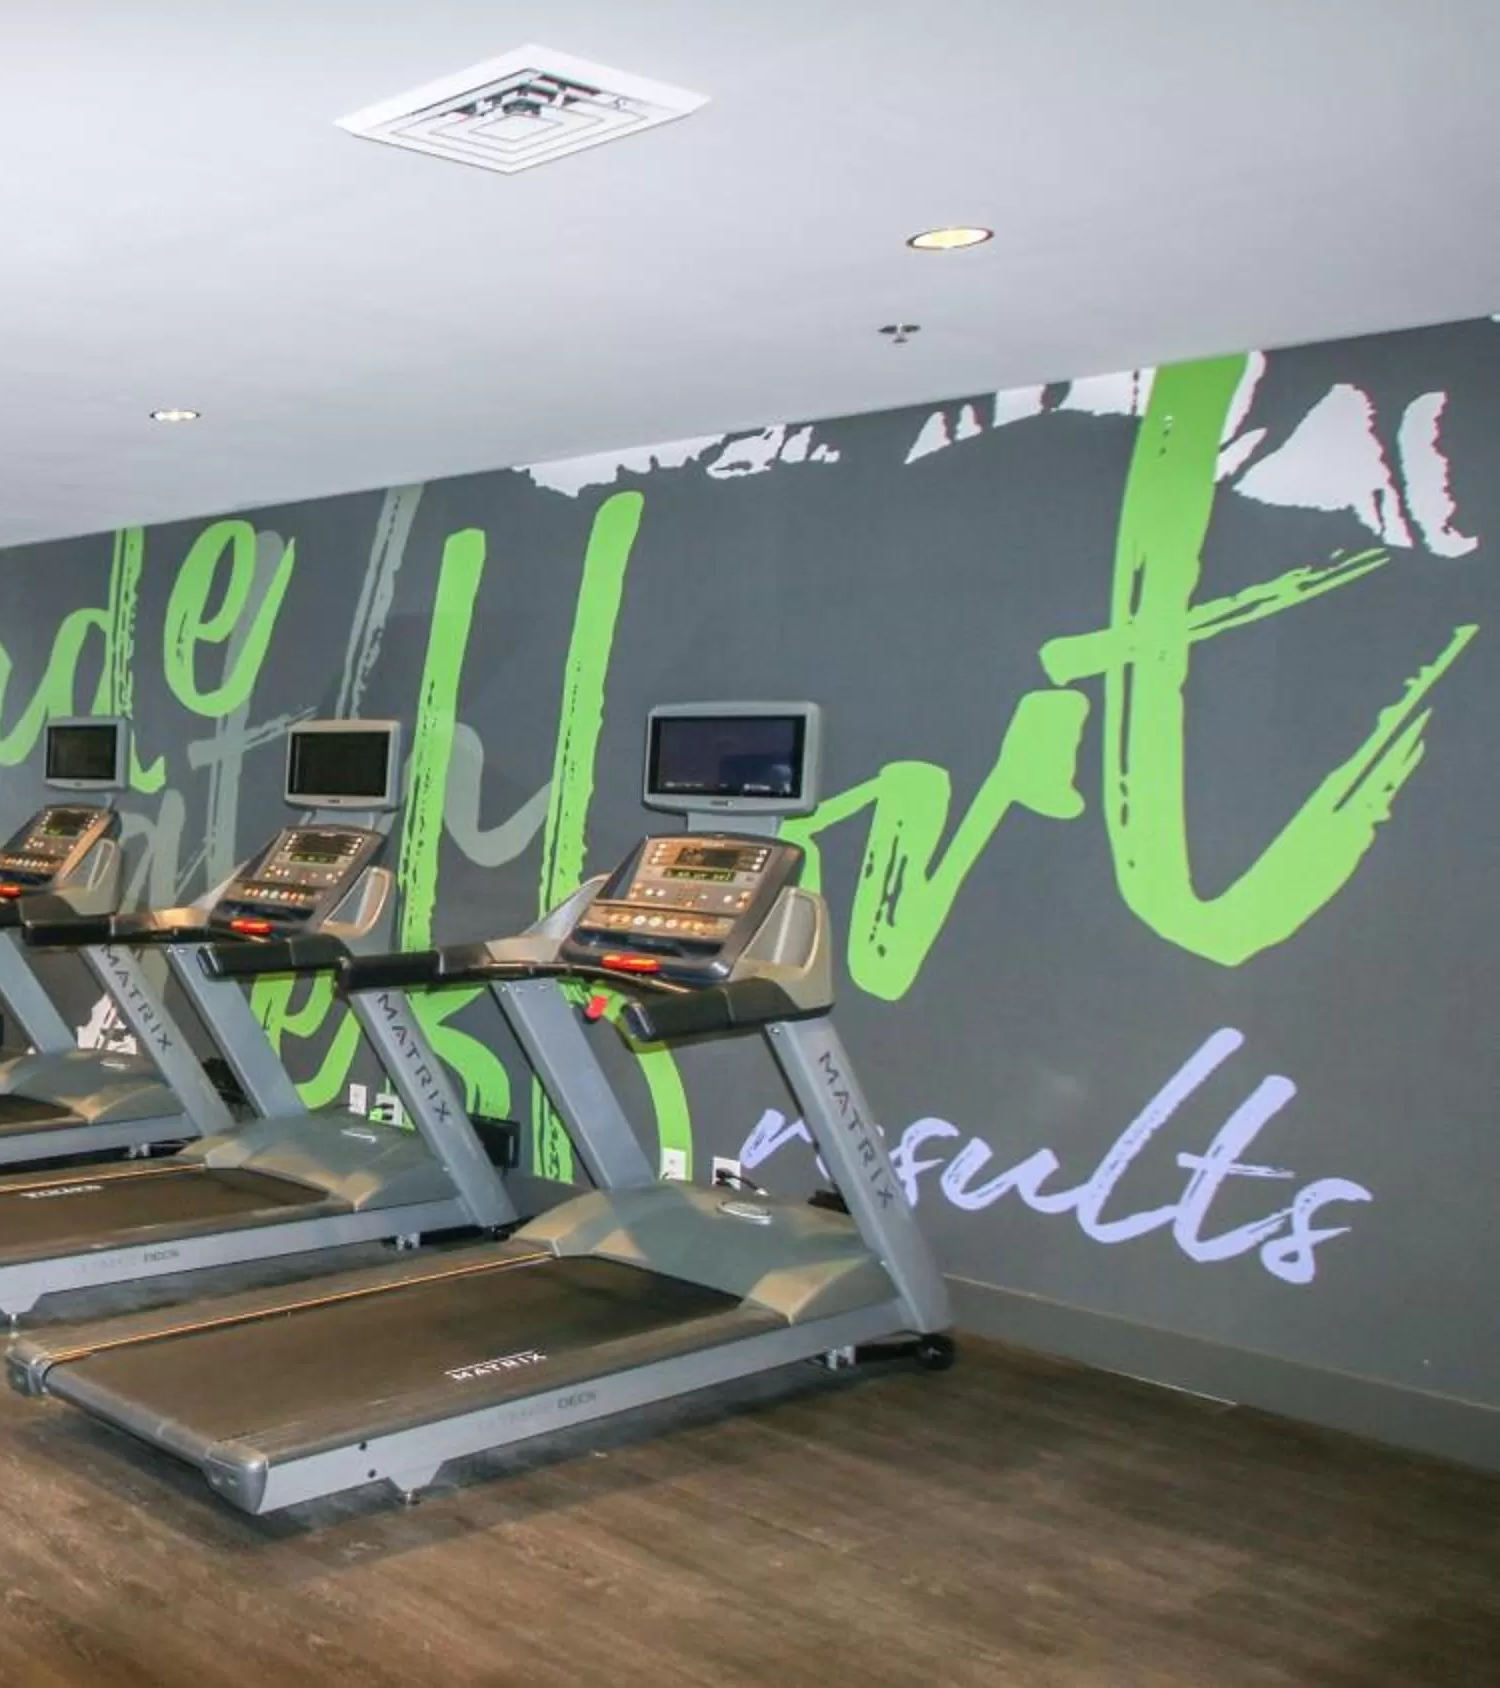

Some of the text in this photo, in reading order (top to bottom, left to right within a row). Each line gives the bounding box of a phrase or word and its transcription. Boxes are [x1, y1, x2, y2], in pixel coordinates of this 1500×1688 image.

[101, 944, 173, 1052] MATRIX
[377, 992, 453, 1125] MATRIX
[739, 1026, 1374, 1284] rsults
[818, 1050, 894, 1209] MATRIX
